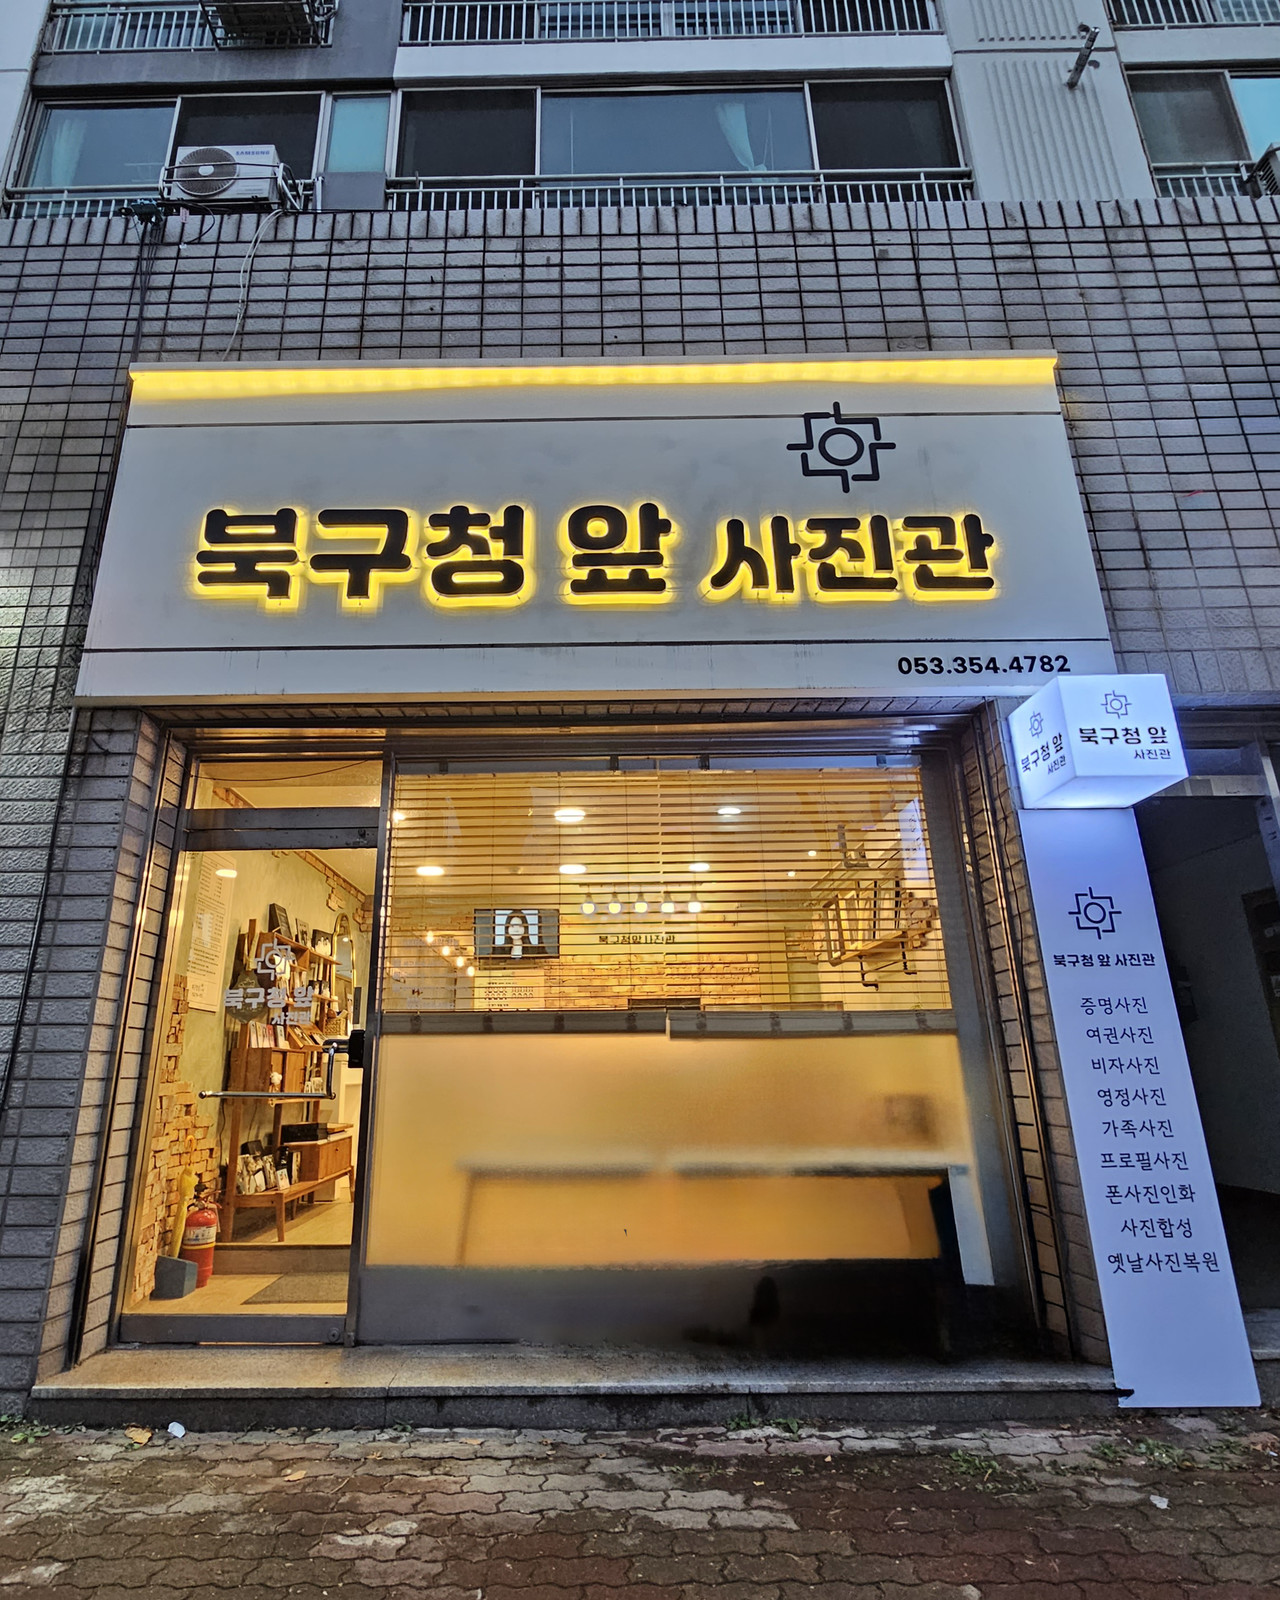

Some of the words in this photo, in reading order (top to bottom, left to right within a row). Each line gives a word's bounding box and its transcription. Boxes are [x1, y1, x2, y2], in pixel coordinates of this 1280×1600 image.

[196, 504, 525, 599] 북구청
[567, 502, 672, 595] 앞
[710, 513, 995, 594] 사진관
[898, 654, 1072, 675] 053.354.4782
[1078, 726, 1141, 745] 북구청
[1147, 725, 1169, 744] 앞
[1020, 741, 1052, 773] 북구청
[1052, 732, 1064, 753] 앞
[1133, 748, 1172, 760] 사진관
[1046, 757, 1067, 775] 사진관
[1053, 953, 1095, 968] 북구청
[1097, 953, 1111, 967] 앞
[1114, 953, 1156, 967] 사진관
[224, 986, 287, 1010] 북구청
[293, 985, 314, 1008] 앞
[1080, 996, 1149, 1016] 증명사진
[271, 1011, 311, 1025] 사진관
[1086, 1026, 1155, 1044] 여권사진
[1091, 1056, 1161, 1075] 비자사진
[1097, 1087, 1167, 1108] 영정사진
[1101, 1118, 1175, 1139] 가족사진
[1100, 1151, 1190, 1171] 프로필사진
[1105, 1183, 1196, 1205] 폰사진인화
[1120, 1217, 1193, 1239] 사진합성
[1107, 1251, 1221, 1274] 옛날사진복원
